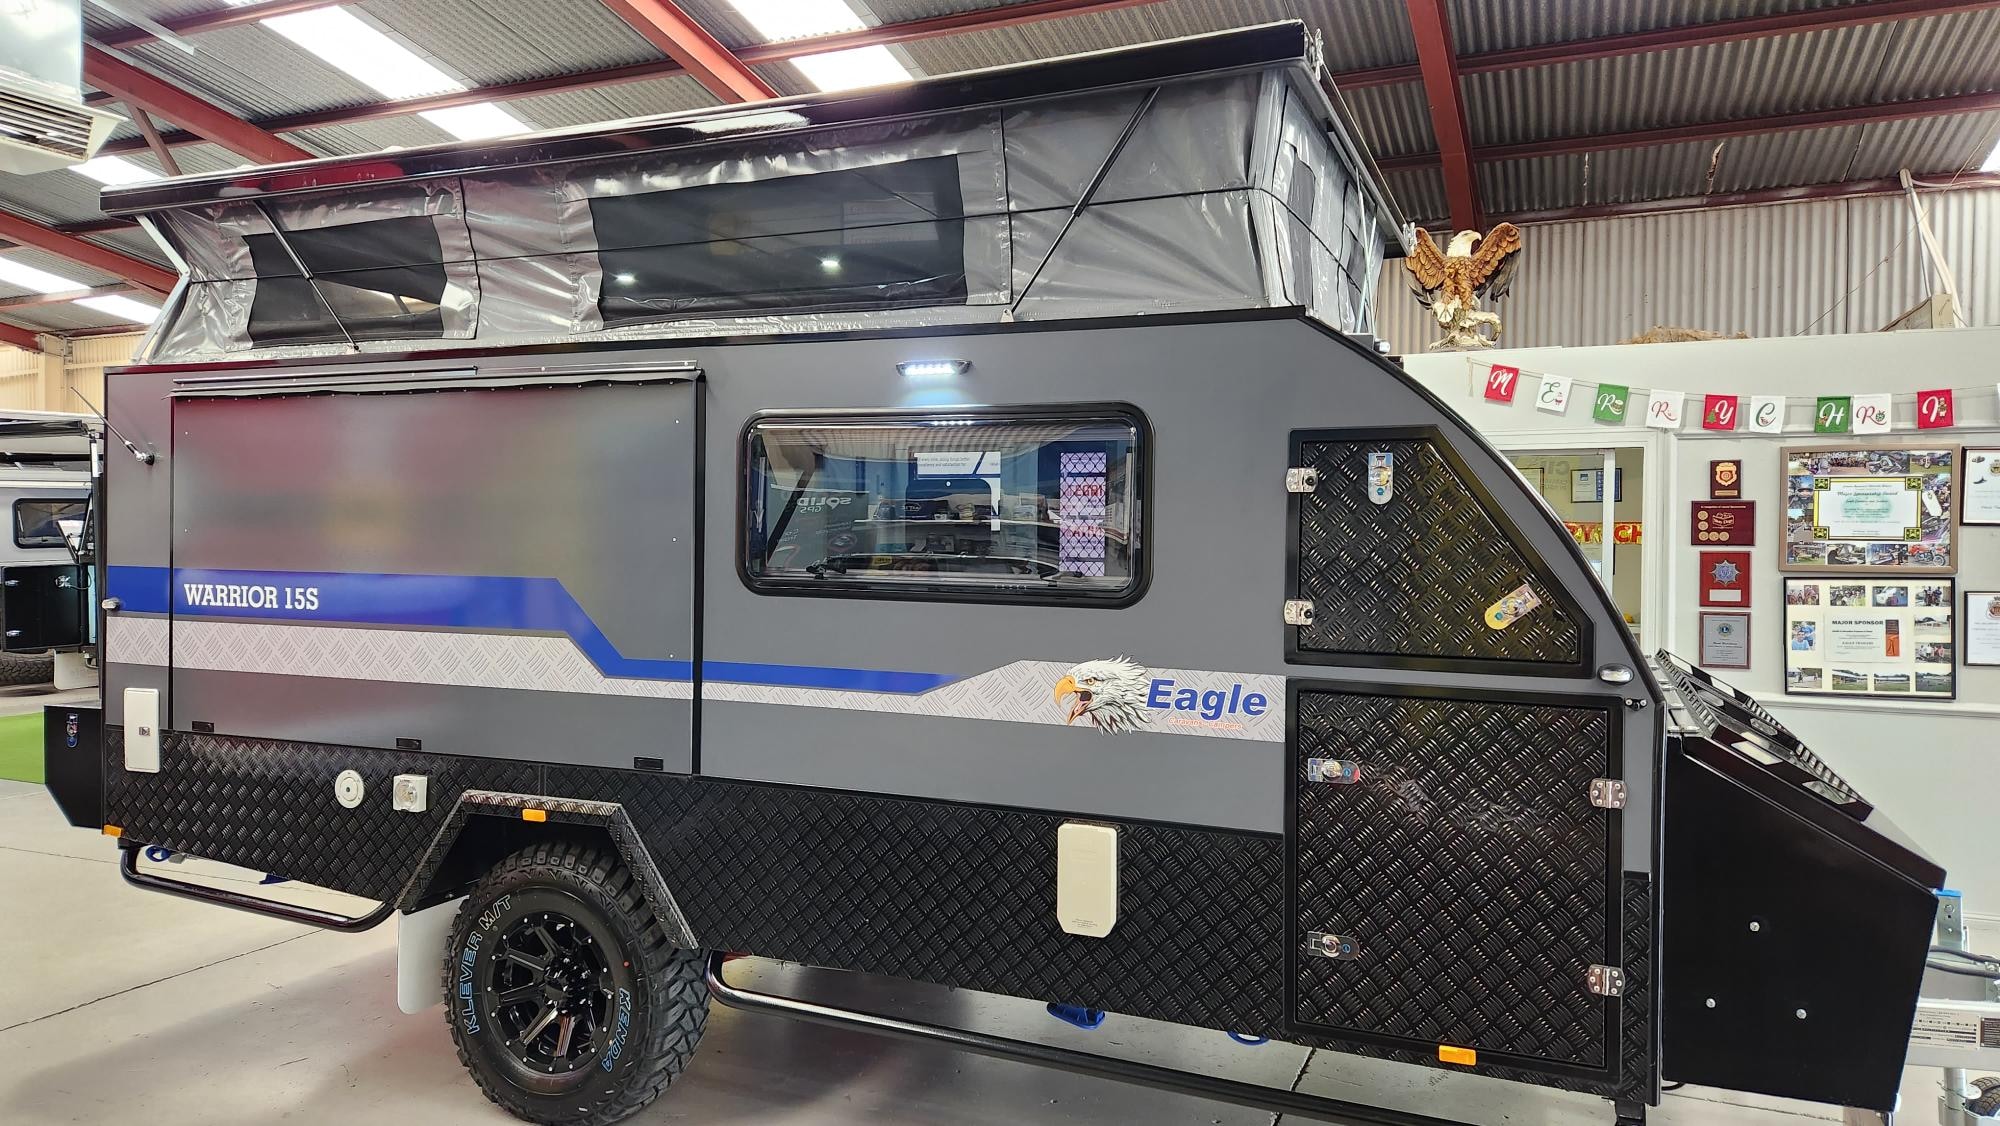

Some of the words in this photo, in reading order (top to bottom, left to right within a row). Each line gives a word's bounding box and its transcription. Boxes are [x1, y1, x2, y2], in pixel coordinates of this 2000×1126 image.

[184, 583, 279, 608] WARRIOR
[285, 587, 319, 611] 15S
[1146, 677, 1268, 721] Eagle
[460, 931, 483, 1034] KLEVER
[478, 894, 511, 930] M/T
[601, 987, 631, 1072] KENDA
